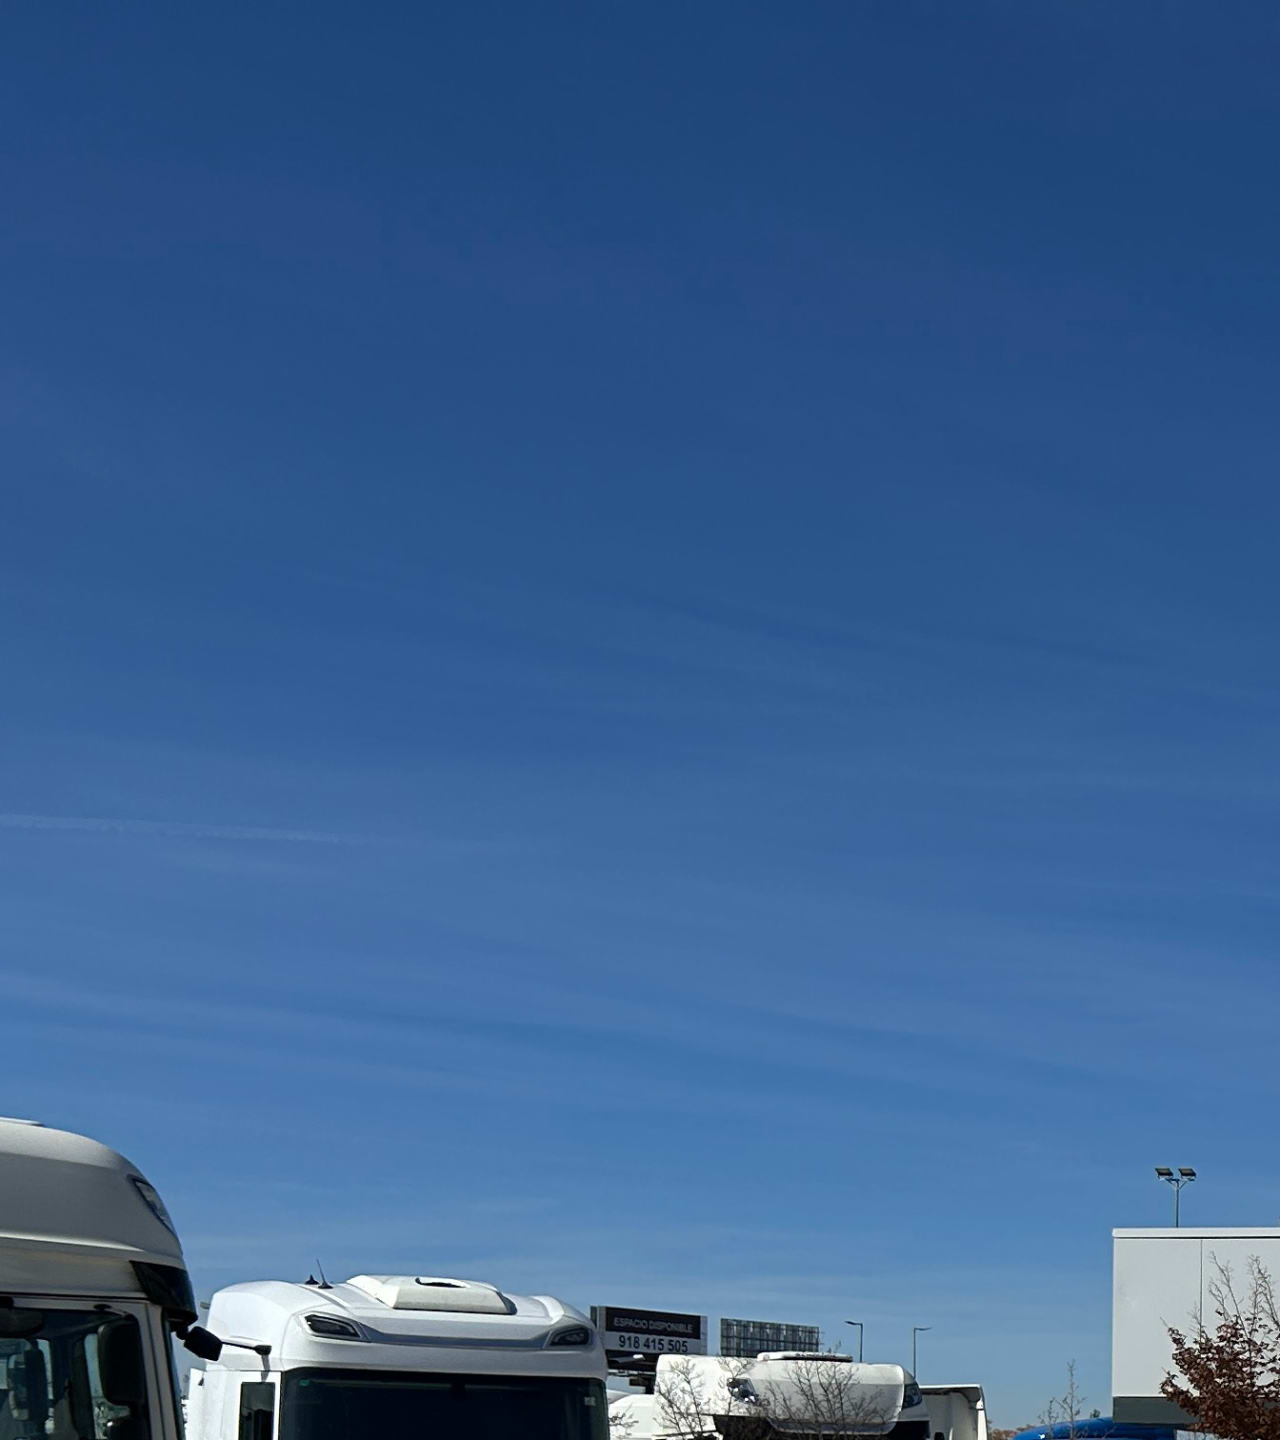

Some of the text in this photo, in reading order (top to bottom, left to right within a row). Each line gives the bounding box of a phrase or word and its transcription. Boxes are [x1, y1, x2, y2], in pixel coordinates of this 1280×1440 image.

[618, 1335, 688, 1352] 918 415 505
